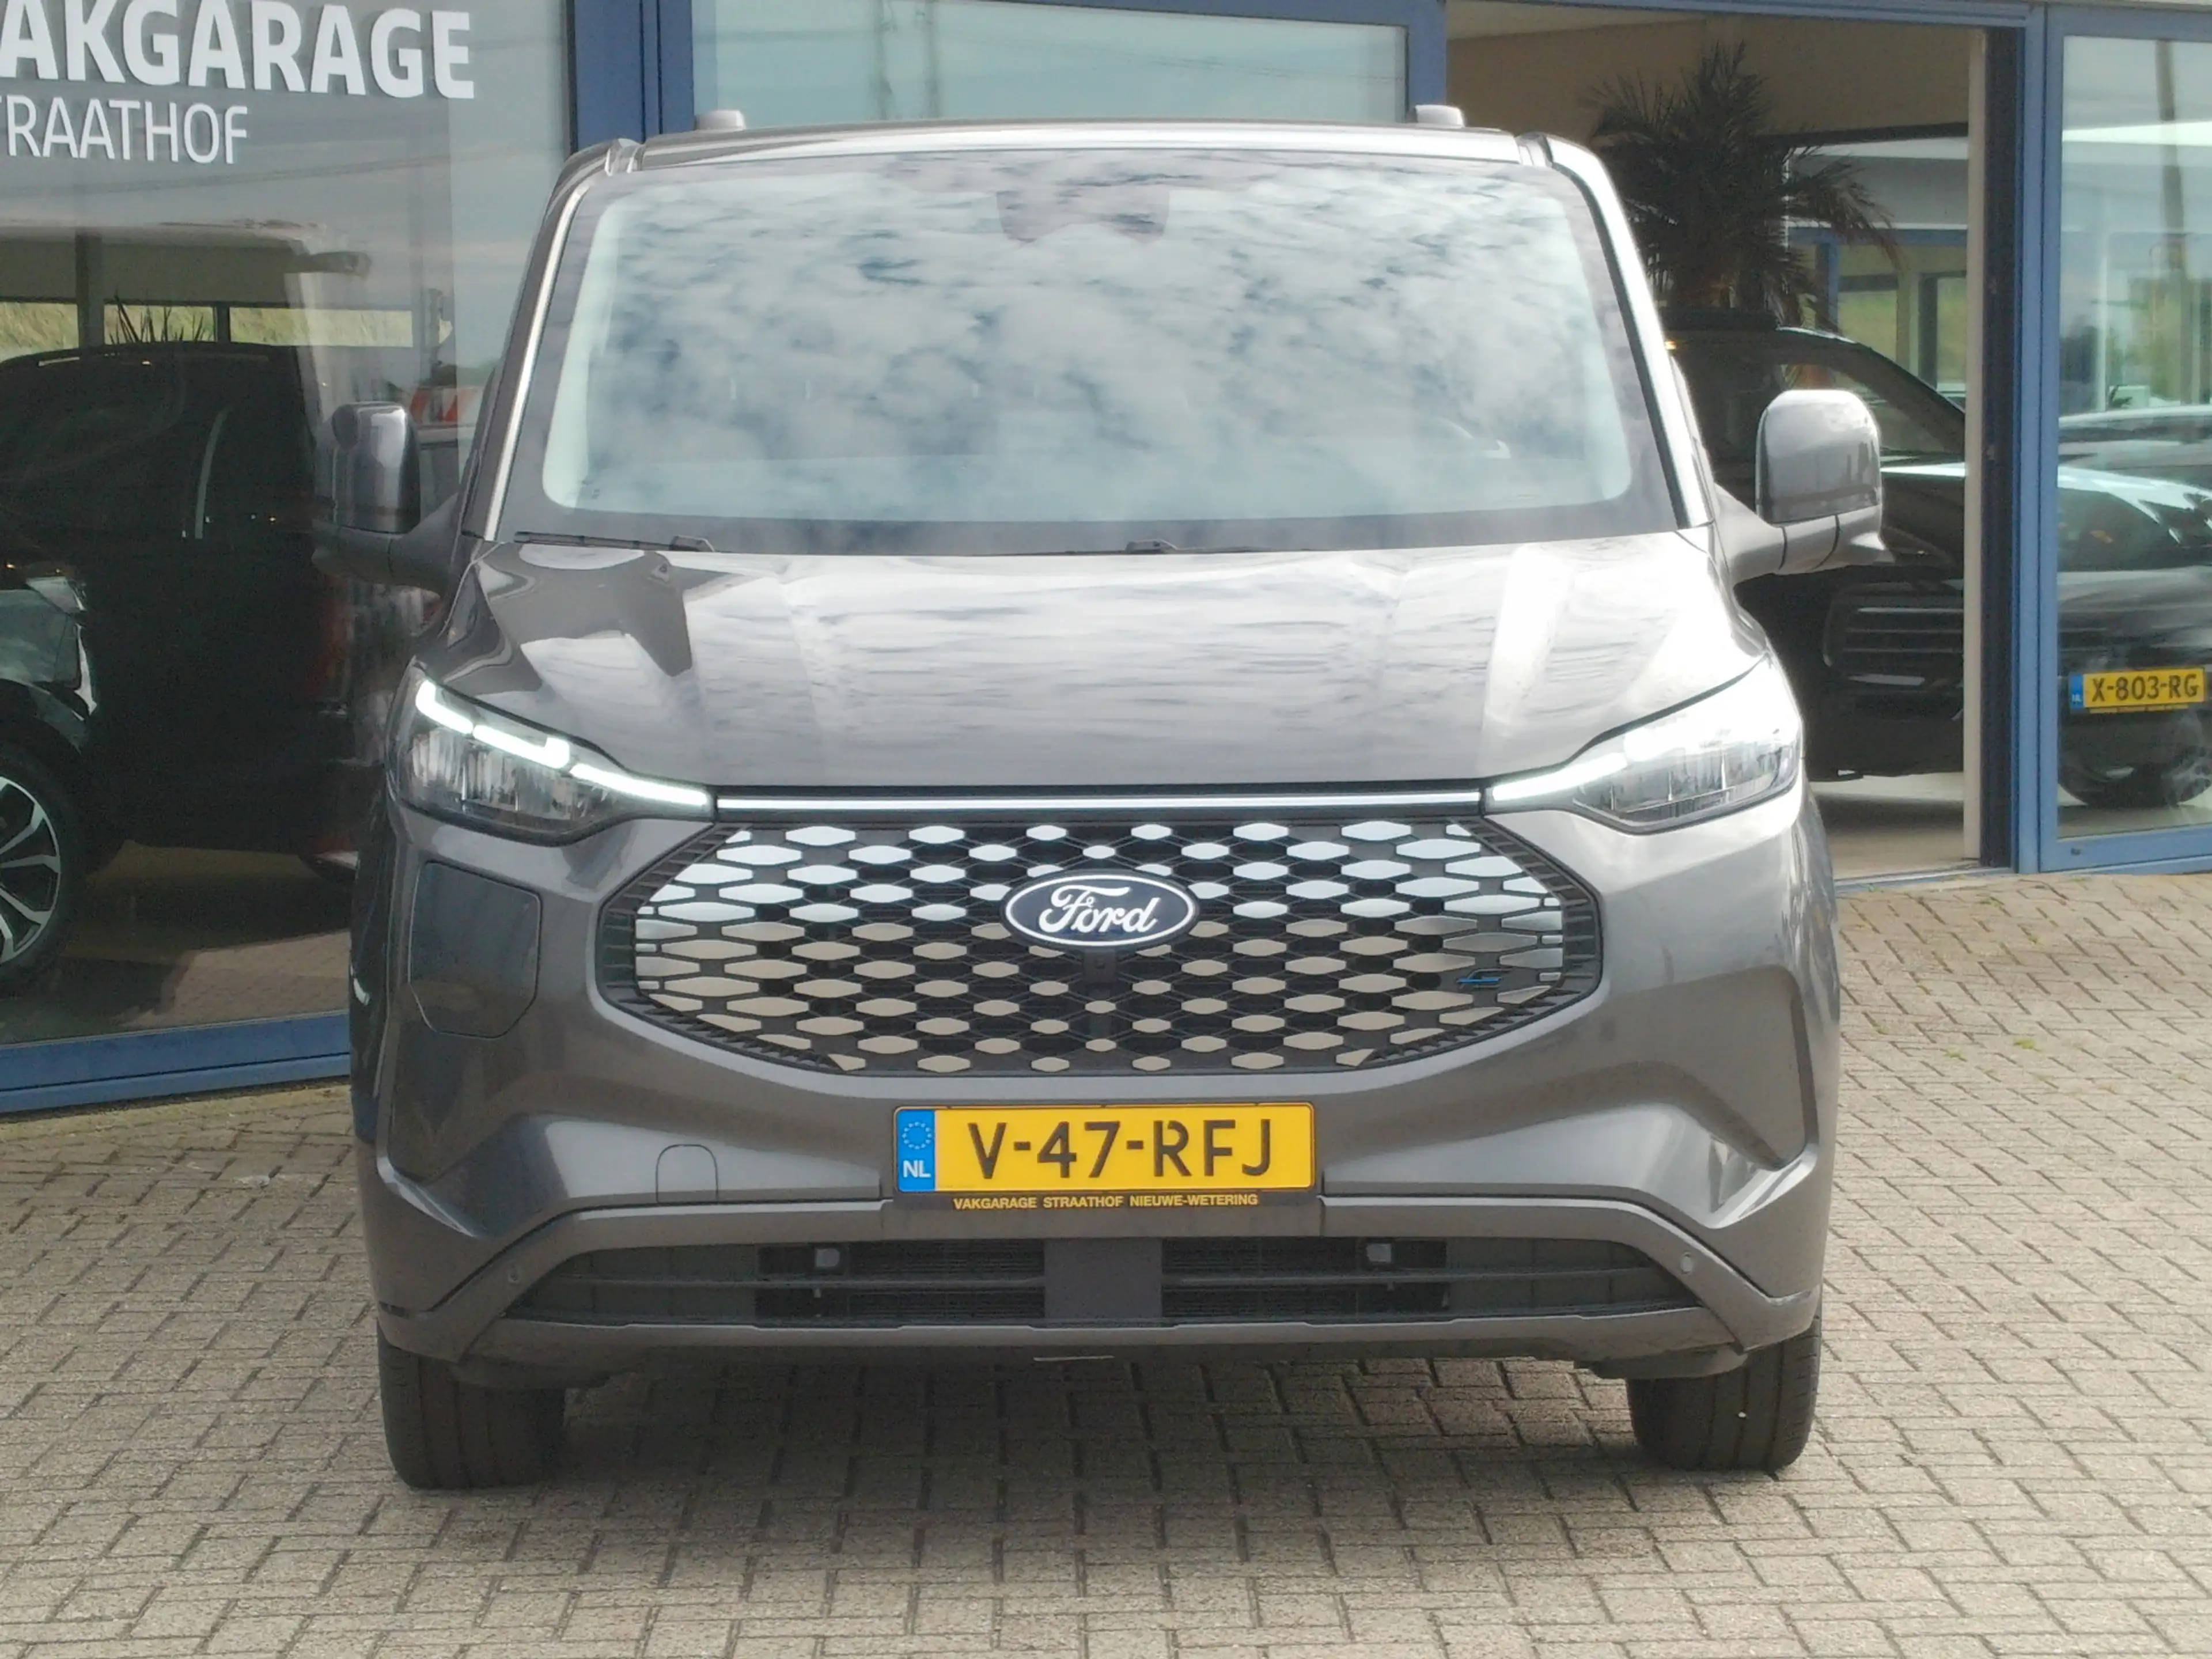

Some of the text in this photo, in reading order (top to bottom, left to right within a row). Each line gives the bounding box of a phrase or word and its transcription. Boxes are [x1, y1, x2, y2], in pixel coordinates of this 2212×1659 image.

[0, 0, 475, 99] AKGARAGE
[0, 94, 248, 165] RAATHOF
[2092, 673, 2199, 702] X-803-RG
[1039, 885, 1161, 933] Ford
[903, 1161, 931, 1179] NL
[967, 1119, 1272, 1180] V-47-RFJ
[953, 1194, 1258, 1210] VAKGARAGE STRAATHOF NIEUWE-WETERING
